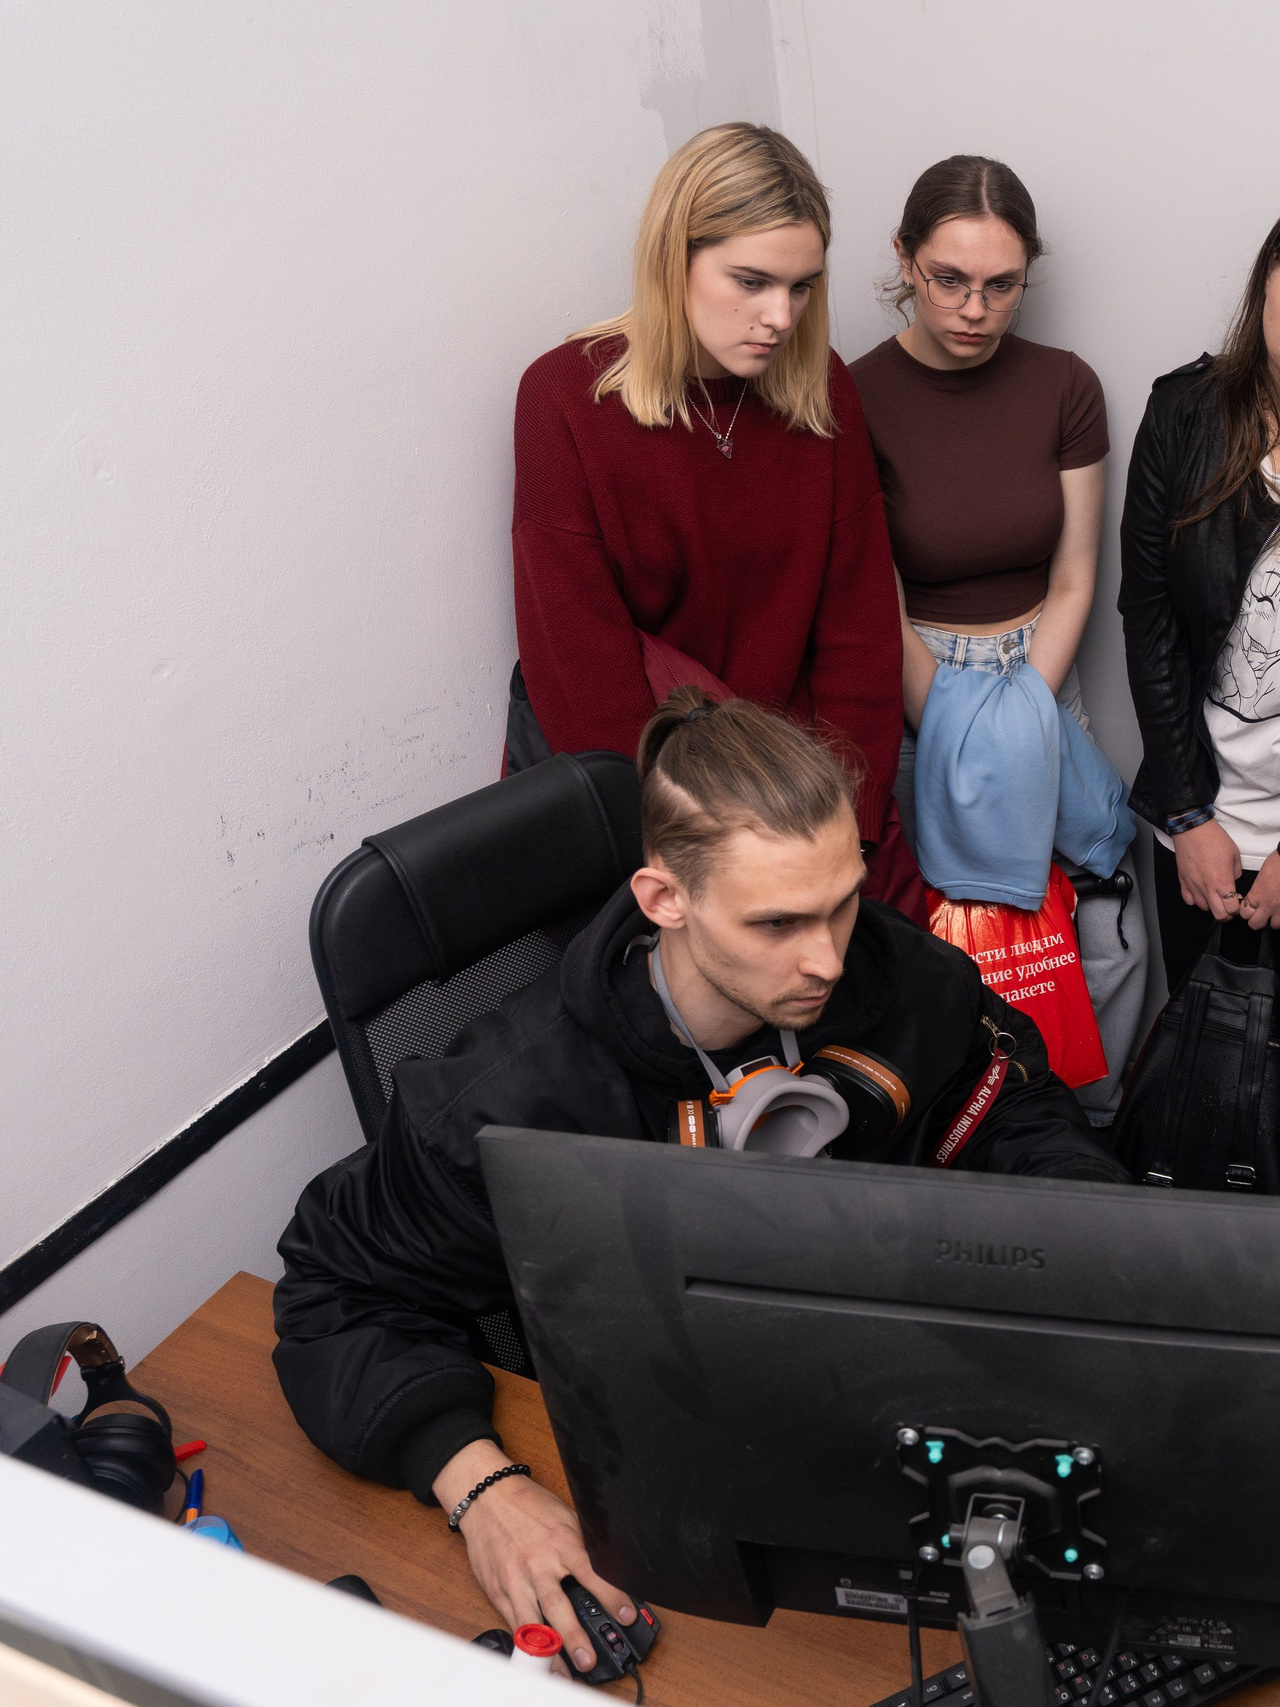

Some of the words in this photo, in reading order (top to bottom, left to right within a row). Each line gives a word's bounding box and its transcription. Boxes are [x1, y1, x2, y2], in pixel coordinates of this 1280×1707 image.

[1015, 951, 1076, 982] удобнее
[999, 980, 1056, 1003] пакете
[967, 1085, 992, 1116] ALPHA
[936, 1114, 974, 1163] INDUSTRIES
[936, 1240, 1045, 1270] PHILIPS
